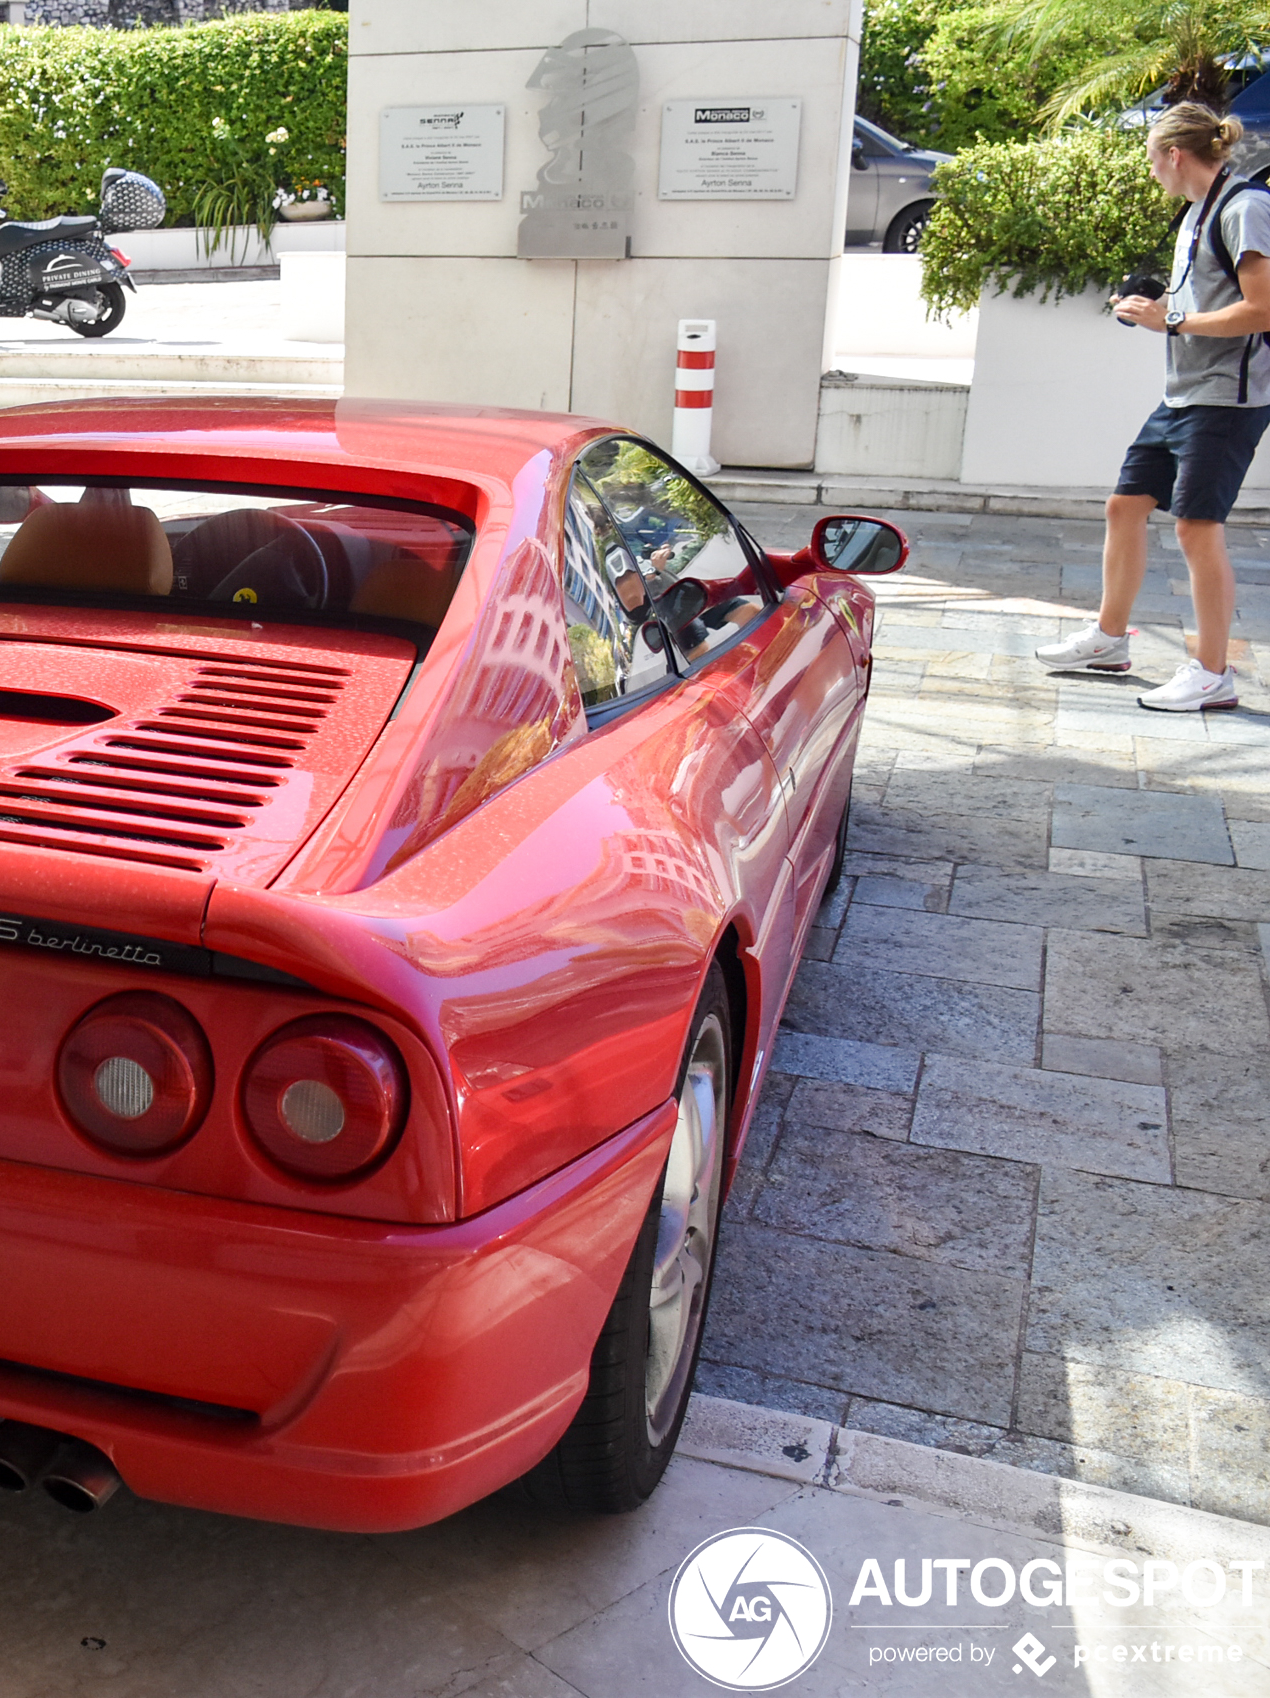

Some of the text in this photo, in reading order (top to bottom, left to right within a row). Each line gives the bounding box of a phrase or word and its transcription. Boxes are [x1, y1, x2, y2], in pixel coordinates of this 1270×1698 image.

[696, 110, 749, 121] Monaco
[417, 181, 463, 190] Ayrton Senna
[701, 179, 752, 188] Ayrton Senna
[42, 268, 101, 282] PRIVATE DINING
[27, 929, 161, 966] berlinetta
